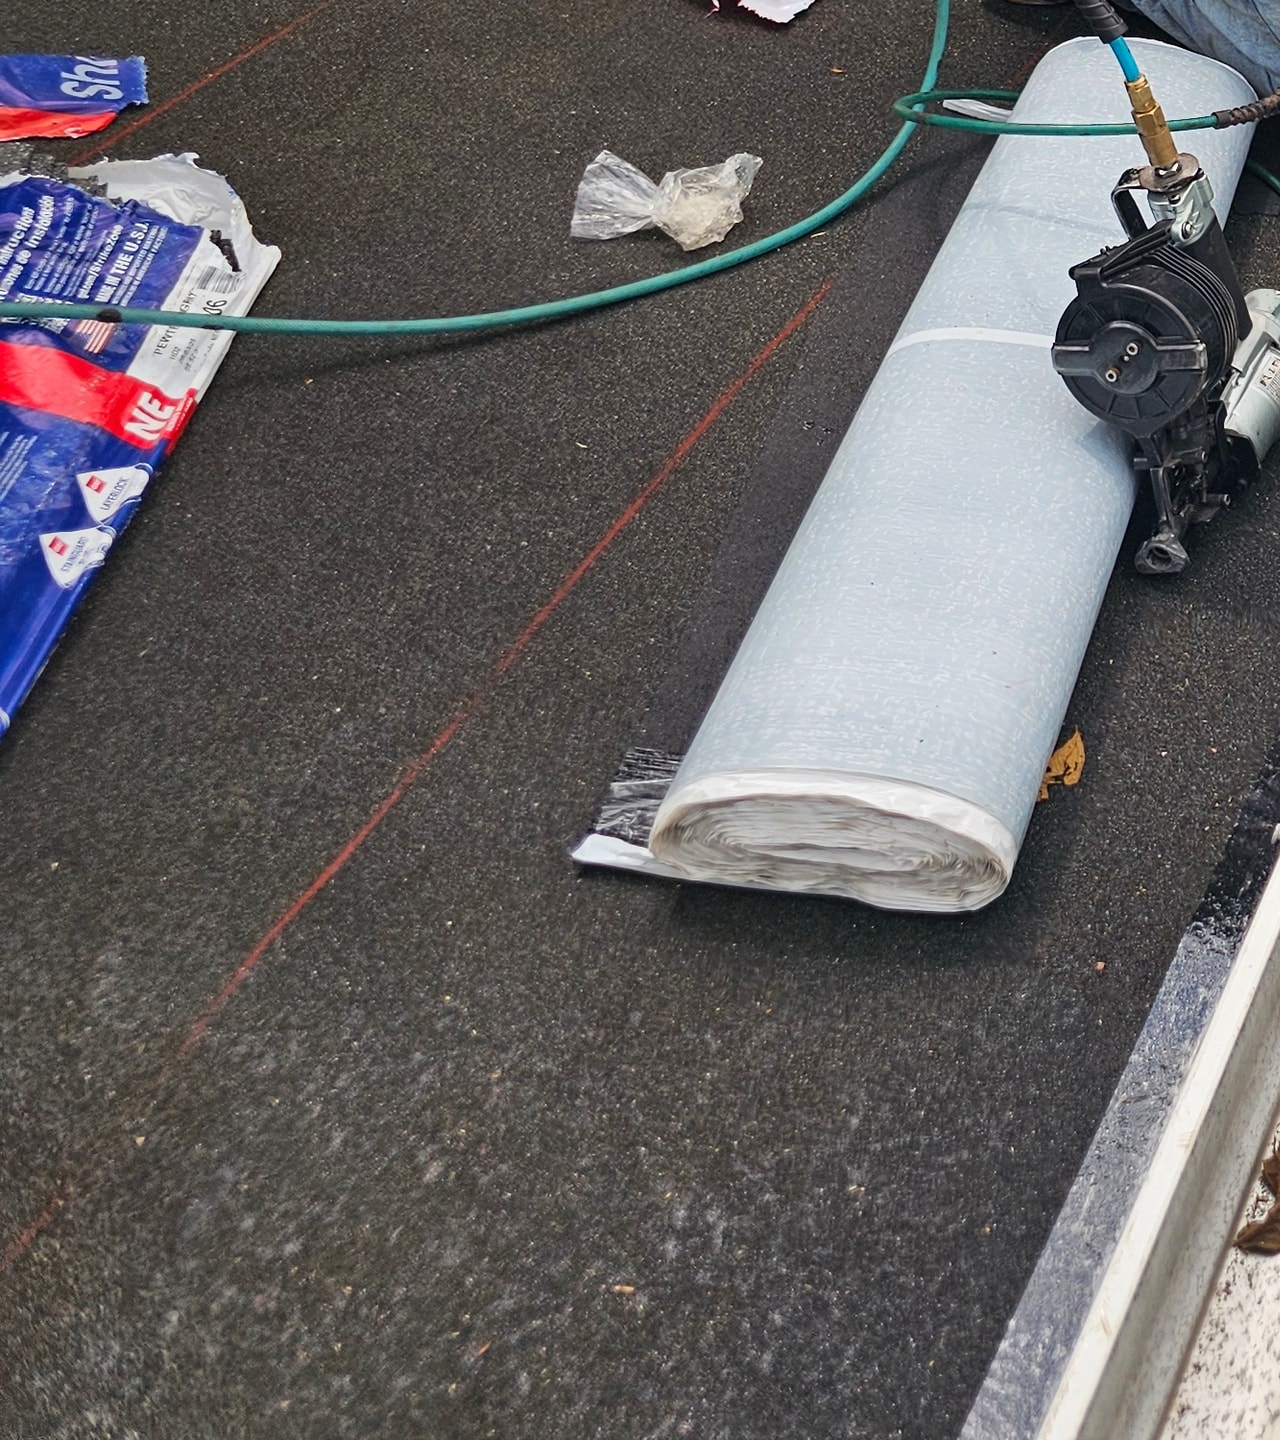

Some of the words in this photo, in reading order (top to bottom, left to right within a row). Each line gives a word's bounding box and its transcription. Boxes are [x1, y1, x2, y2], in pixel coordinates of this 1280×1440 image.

[109, 250, 133, 274] THE
[153, 324, 178, 355] PEWT
[123, 391, 175, 440] NE
[100, 476, 130, 510] LAYERLOCK
